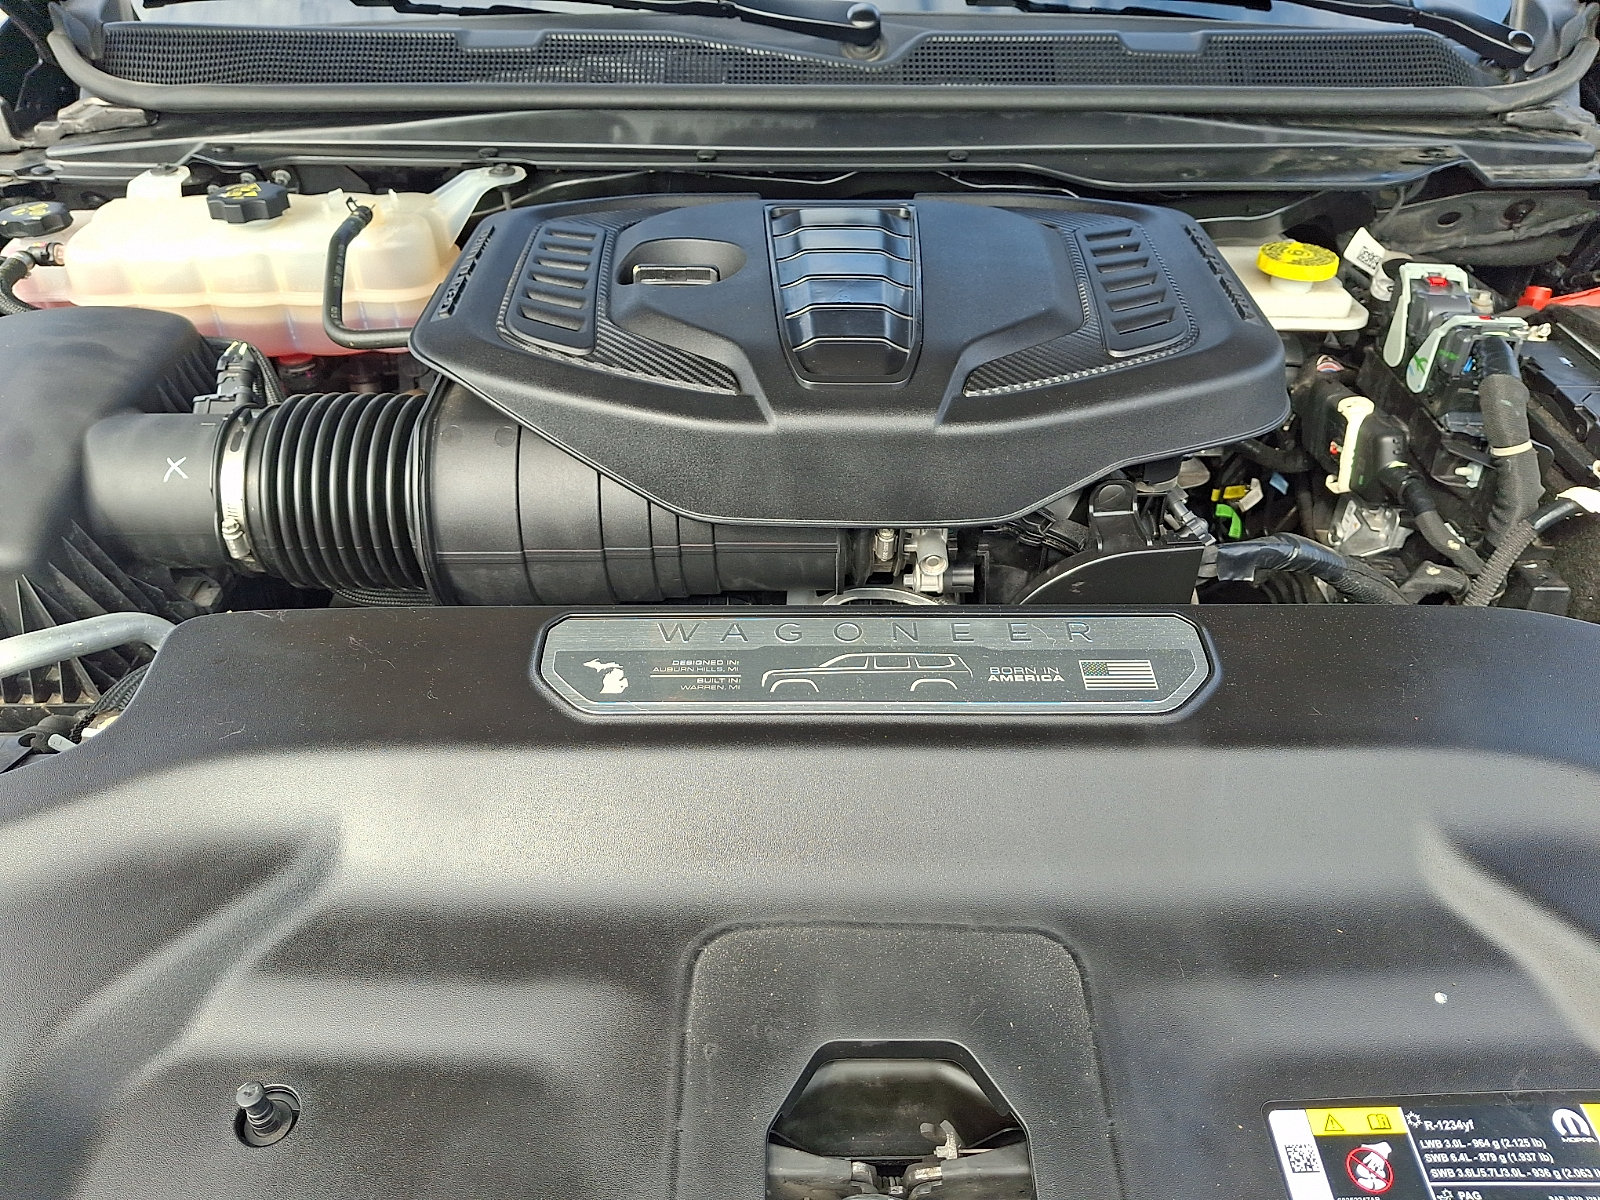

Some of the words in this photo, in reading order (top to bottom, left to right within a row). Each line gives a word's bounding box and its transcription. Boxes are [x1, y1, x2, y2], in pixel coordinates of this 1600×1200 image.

[656, 621, 1094, 643] WAGONEER
[989, 666, 1037, 675] BORN
[1043, 666, 1060, 674] IN
[987, 674, 1066, 682] AMERICA
[1423, 1119, 1475, 1133] R-1234yf
[1419, 1139, 1443, 1148] LWB
[1443, 1138, 1467, 1148] 3.0L
[1471, 1138, 1491, 1148] 964
[1492, 1140, 1500, 1149] g
[1500, 1137, 1531, 1149] (2.125
[1530, 1137, 1547, 1149] lb)
[1424, 1153, 1449, 1163] SWB
[1449, 1152, 1473, 1162] 6.4L
[1477, 1152, 1497, 1162] 879
[1498, 1154, 1508, 1164] g
[1507, 1152, 1537, 1163] (1.937
[1537, 1152, 1554, 1164] lb)
[1430, 1168, 1456, 1178] SWB
[1456, 1167, 1527, 1178] 3.6L/5.7L/3.0L
[1531, 1167, 1552, 1178] 936
[1552, 1169, 1562, 1180] g
[1561, 1168, 1593, 1180] (2.063
[1457, 1191, 1483, 1200] PAG
